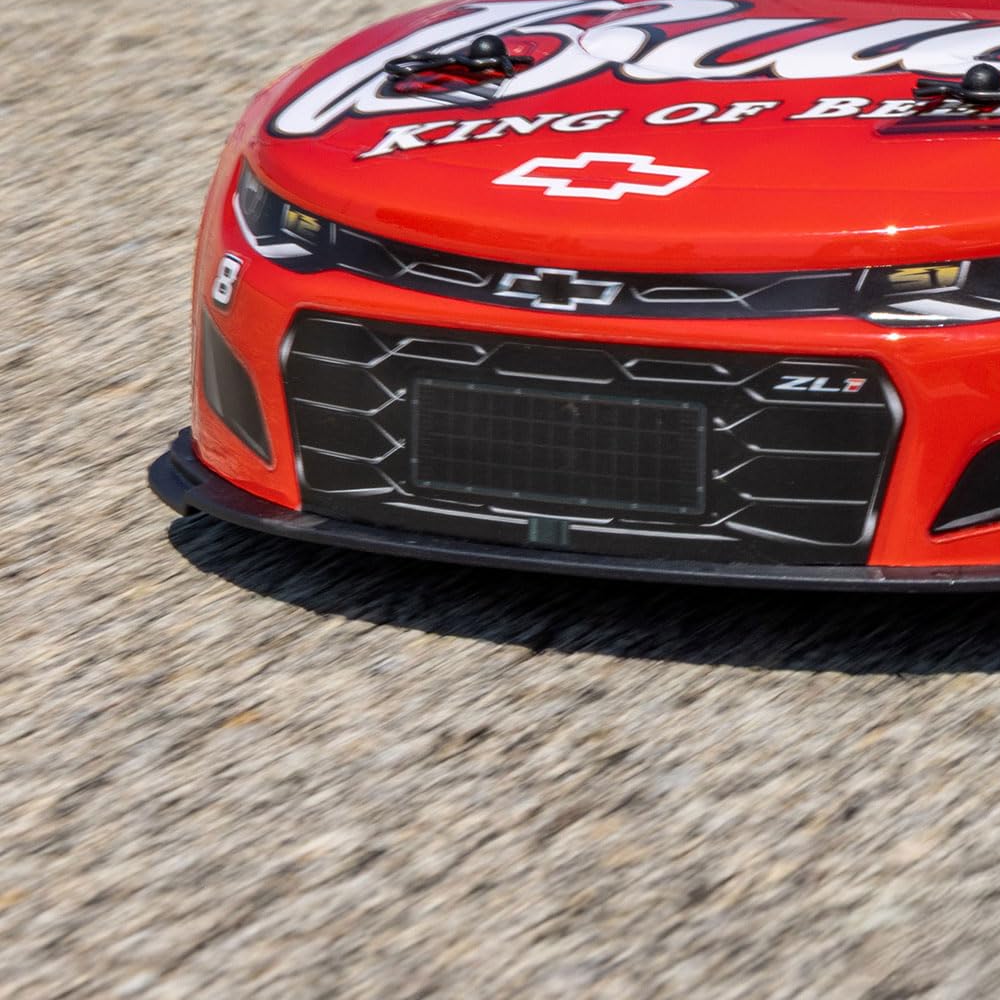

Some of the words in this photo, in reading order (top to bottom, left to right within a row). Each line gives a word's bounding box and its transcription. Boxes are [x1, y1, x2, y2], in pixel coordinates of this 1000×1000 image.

[357, 110, 621, 158] KING
[644, 101, 780, 125] OF
[212, 256, 241, 304] 8
